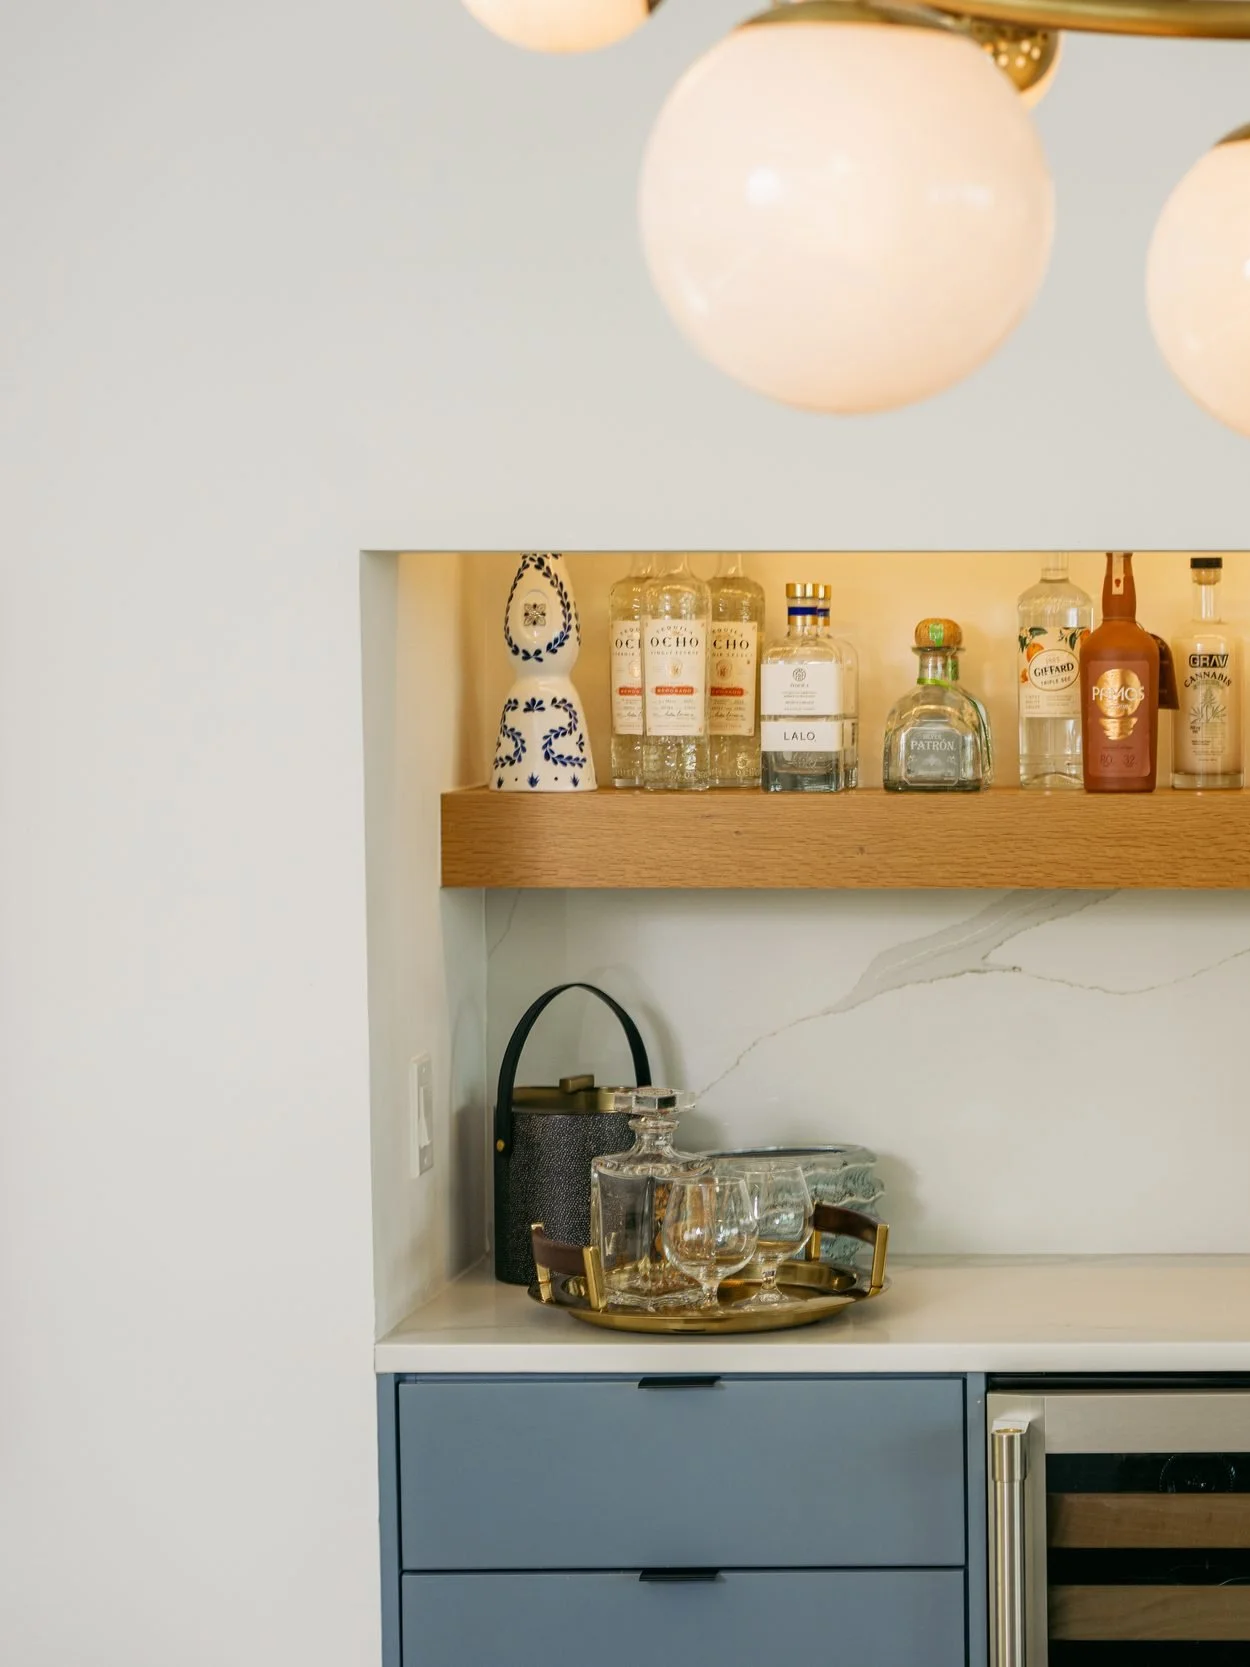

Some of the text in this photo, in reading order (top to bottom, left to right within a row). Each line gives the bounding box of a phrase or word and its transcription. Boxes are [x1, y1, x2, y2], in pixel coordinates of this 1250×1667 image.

[615, 639, 640, 648] OC
[650, 637, 699, 648] OCHO
[713, 639, 749, 650] CHO
[1189, 654, 1228, 668] GRAV
[1033, 662, 1074, 677] GIFFARD
[1184, 671, 1232, 688] CANNABIS
[1092, 686, 1145, 701] PAMOS
[783, 731, 816, 741] LALO
[910, 738, 956, 751] PATRÓN
